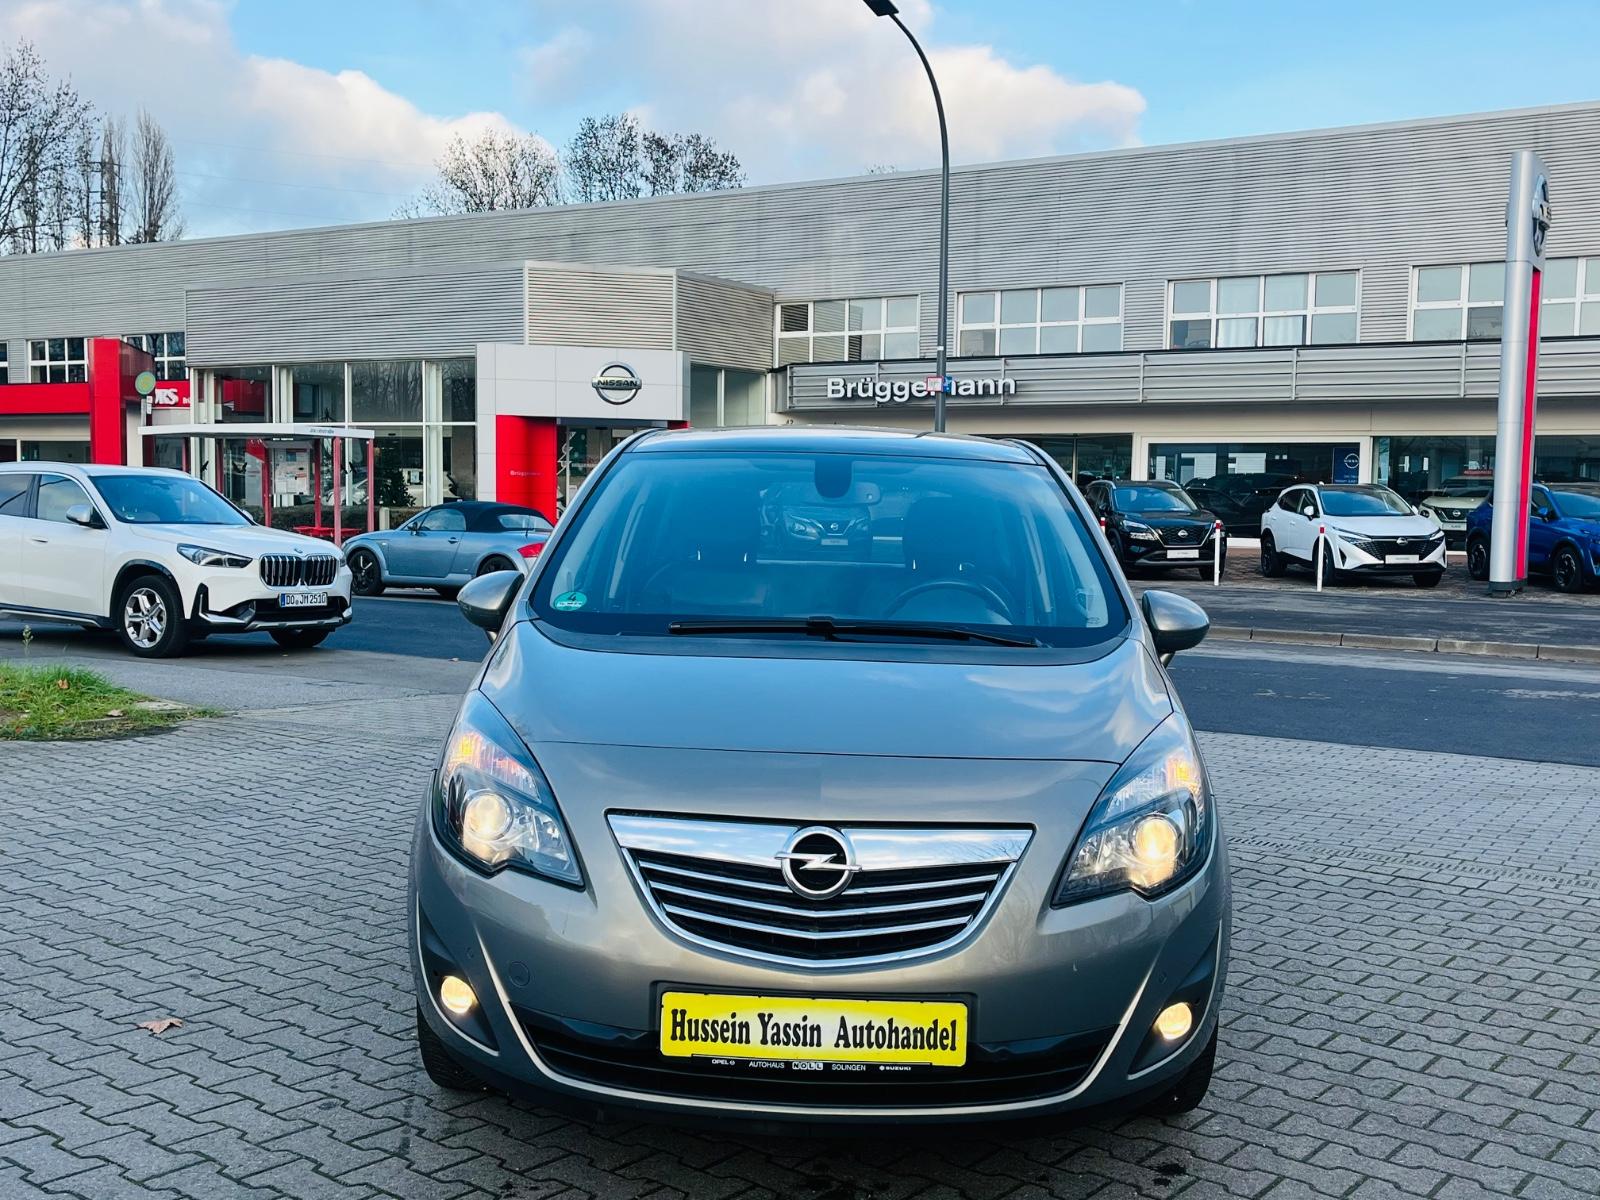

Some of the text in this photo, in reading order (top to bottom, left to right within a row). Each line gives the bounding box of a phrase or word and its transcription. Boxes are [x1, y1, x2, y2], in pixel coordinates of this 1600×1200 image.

[597, 379, 638, 387] NISSAN
[671, 1008, 957, 1051] Hussein Yassin Autohandel
[748, 1060, 785, 1069] AUTOHAUS
[792, 1061, 824, 1071] NOLL
[831, 1063, 867, 1072] SOLINGEN
